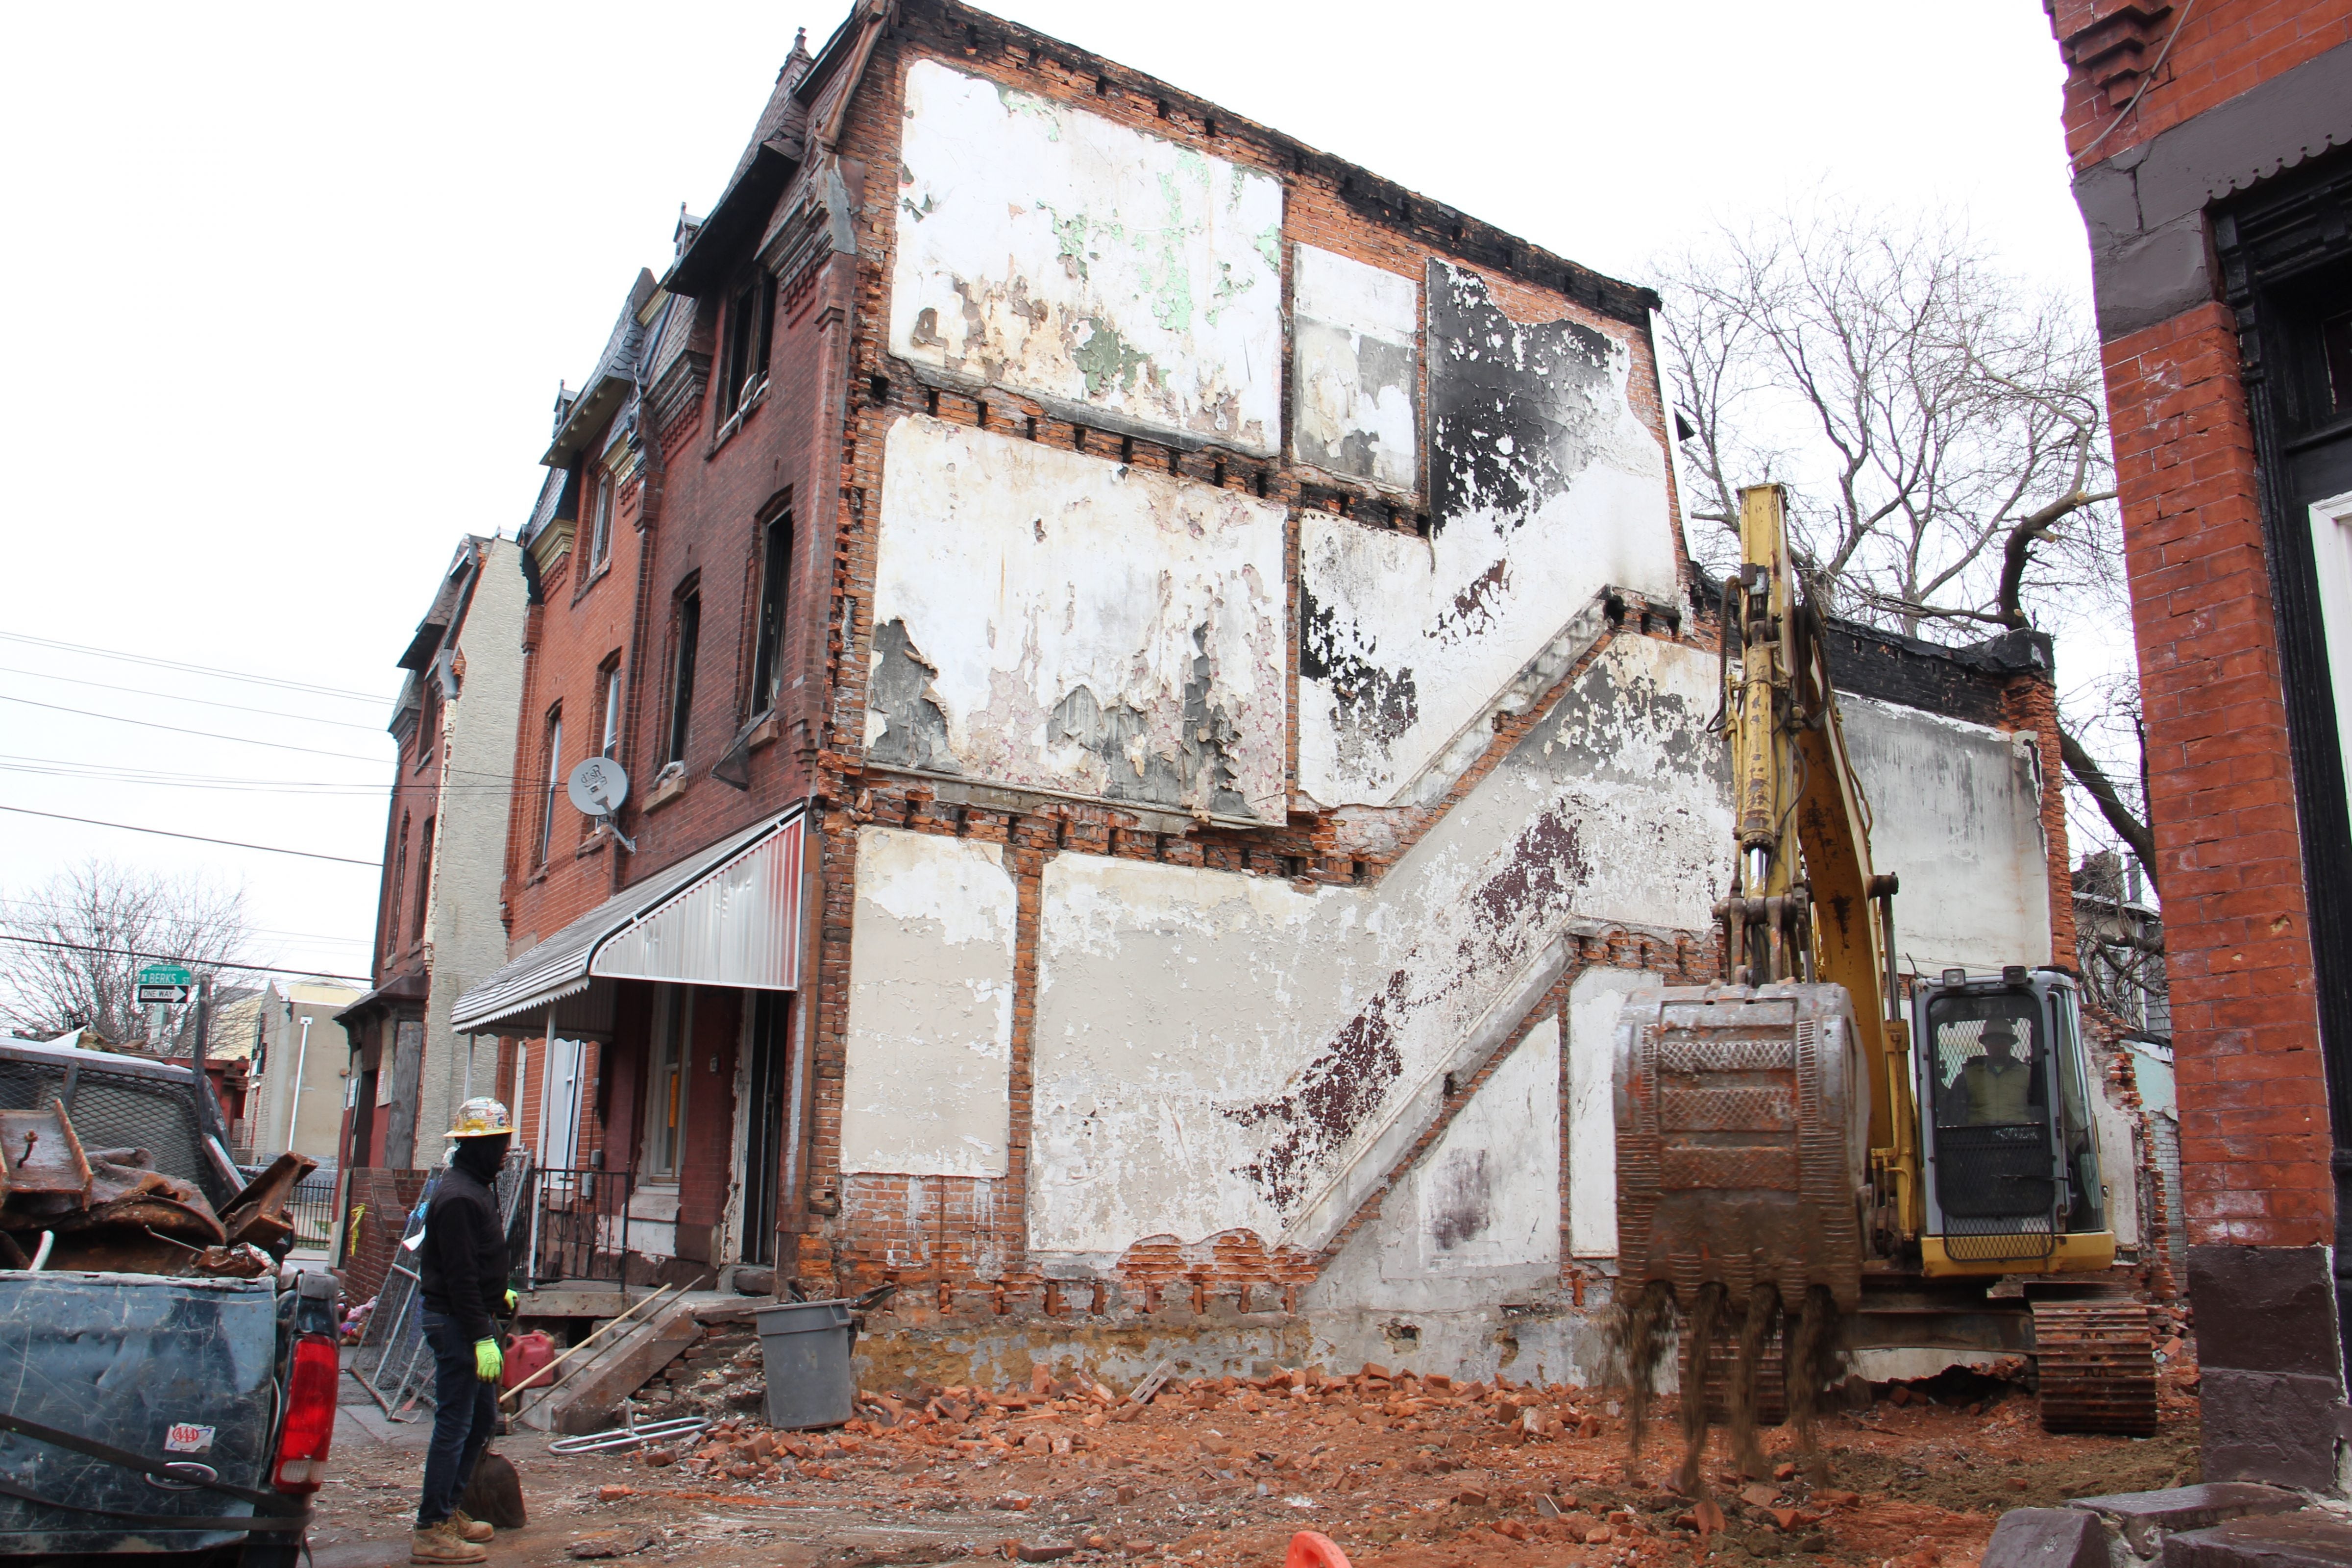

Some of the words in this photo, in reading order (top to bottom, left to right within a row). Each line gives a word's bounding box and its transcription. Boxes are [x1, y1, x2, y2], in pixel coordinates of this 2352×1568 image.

[581, 767, 602, 784] dish
[148, 973, 177, 984] BERKS
[173, 1426, 198, 1443] AAA
